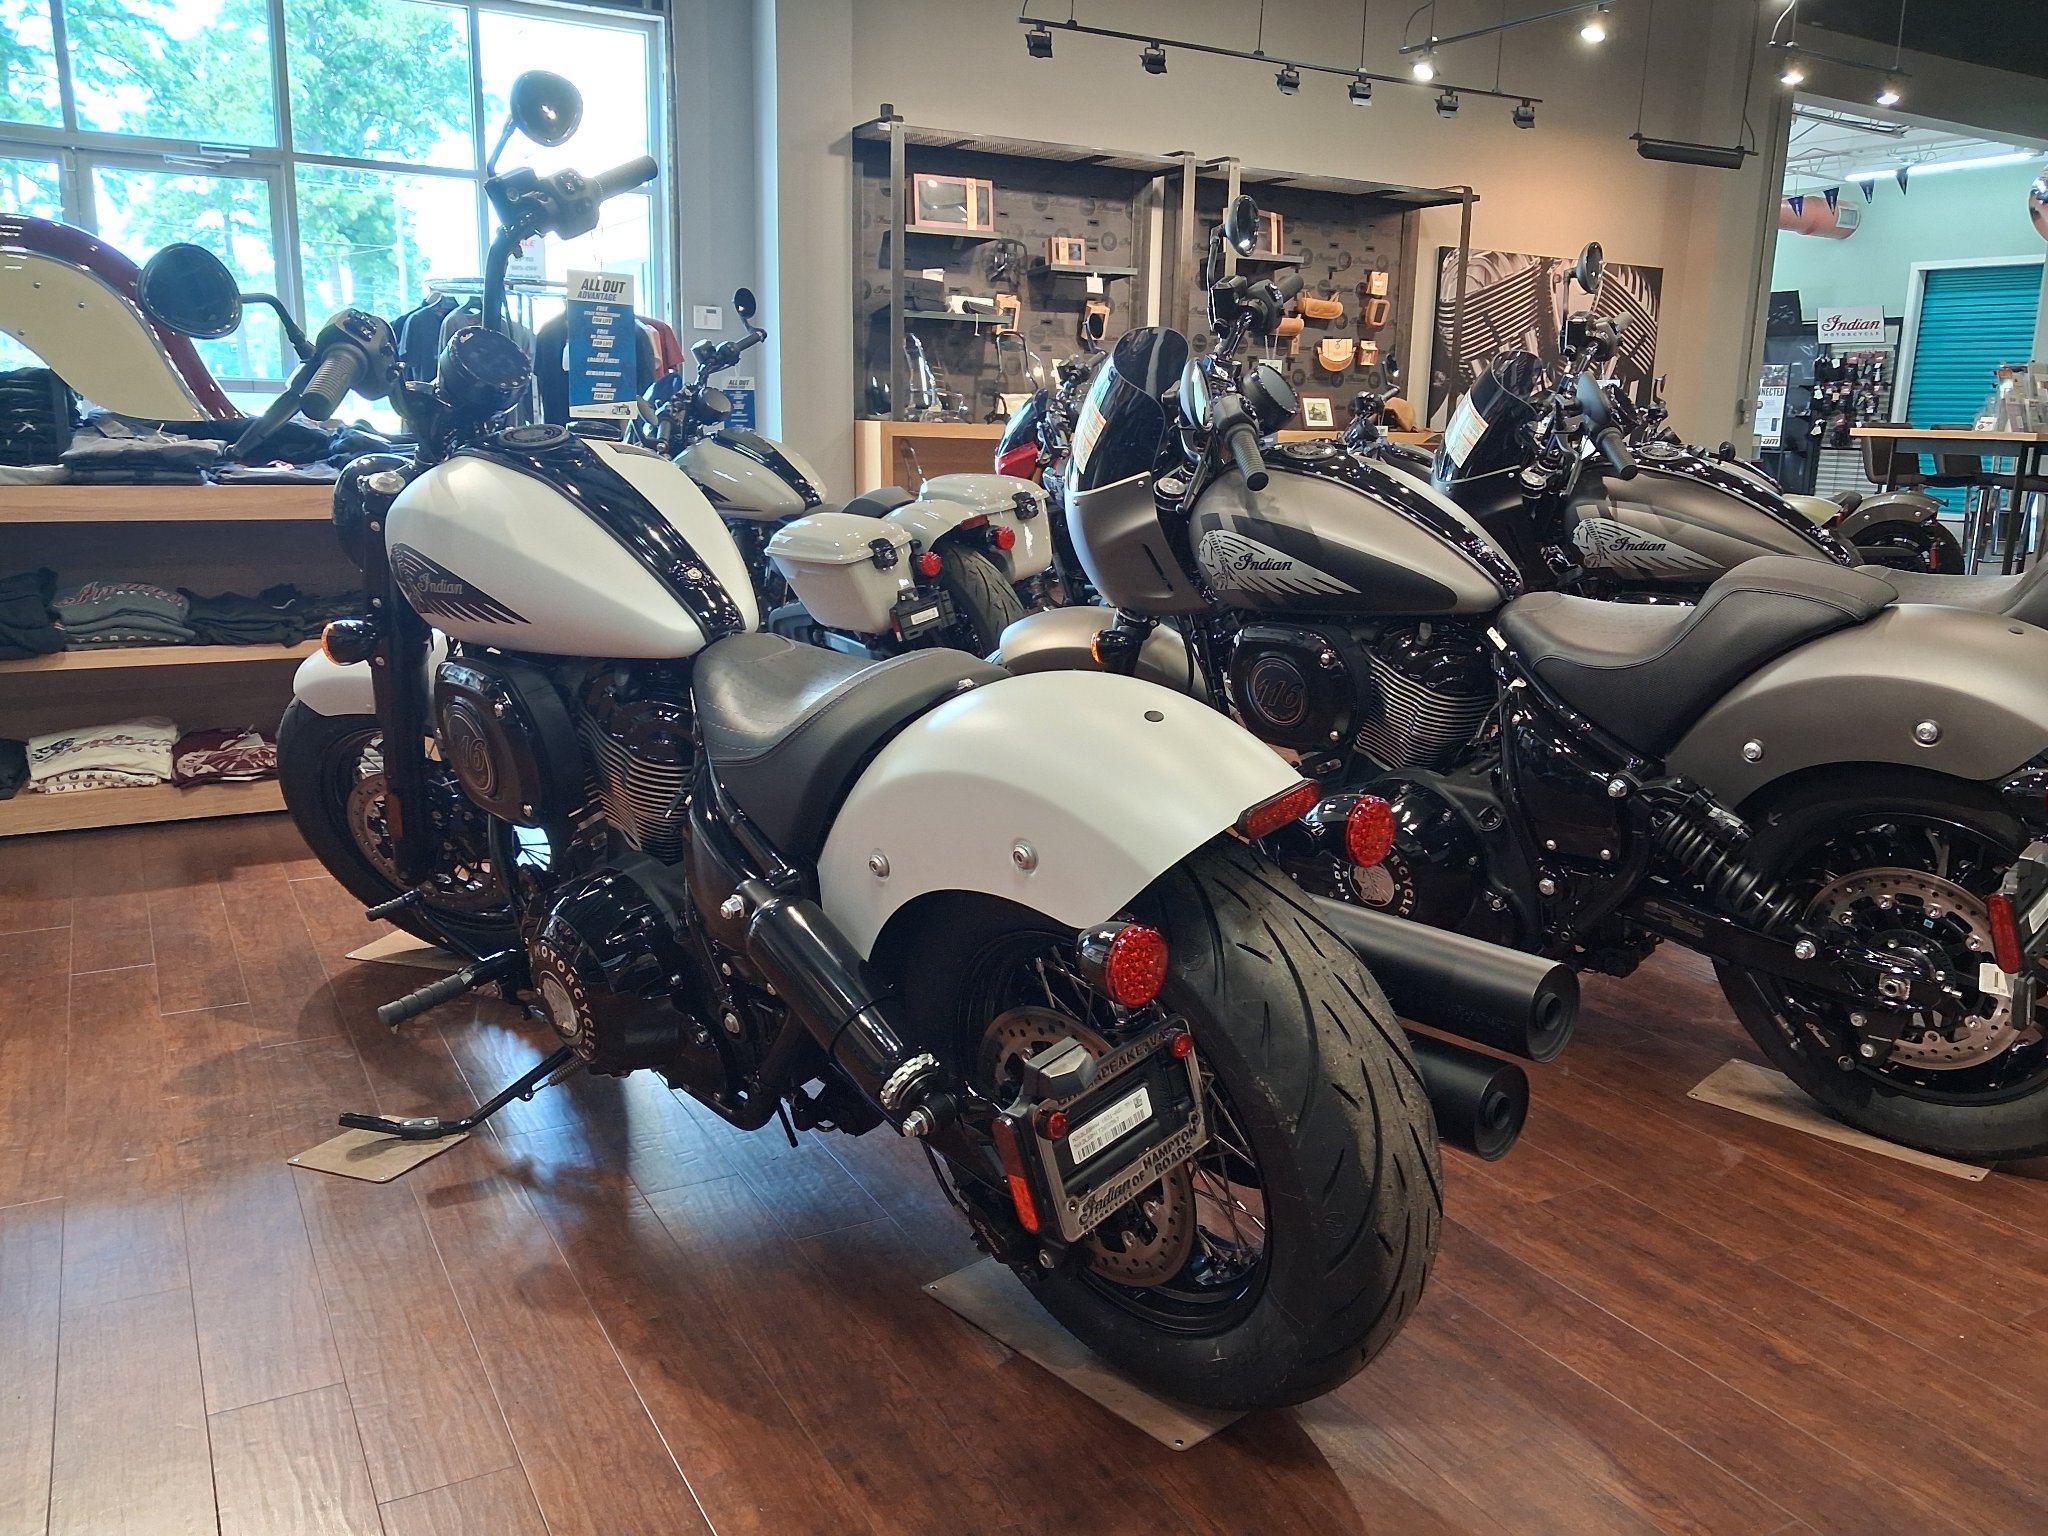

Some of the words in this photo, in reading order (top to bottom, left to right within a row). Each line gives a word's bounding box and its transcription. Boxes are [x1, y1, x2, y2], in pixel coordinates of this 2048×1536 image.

[577, 290, 617, 302] ADVANTAGE
[581, 278, 601, 292] ALL
[603, 280, 626, 294] OUT
[1821, 315, 1880, 332] Indian
[1609, 537, 1667, 551] Indian
[1234, 553, 1293, 571] Indian
[417, 573, 463, 595] Indian
[1256, 679, 1303, 708] 116
[533, 945, 596, 1050] MOTORCYCLE
[1154, 1142, 1193, 1176] ROADS
[1078, 1178, 1131, 1226] Indian
[1132, 1170, 1145, 1187] OF
[1142, 1125, 1198, 1171] HAMPTON
